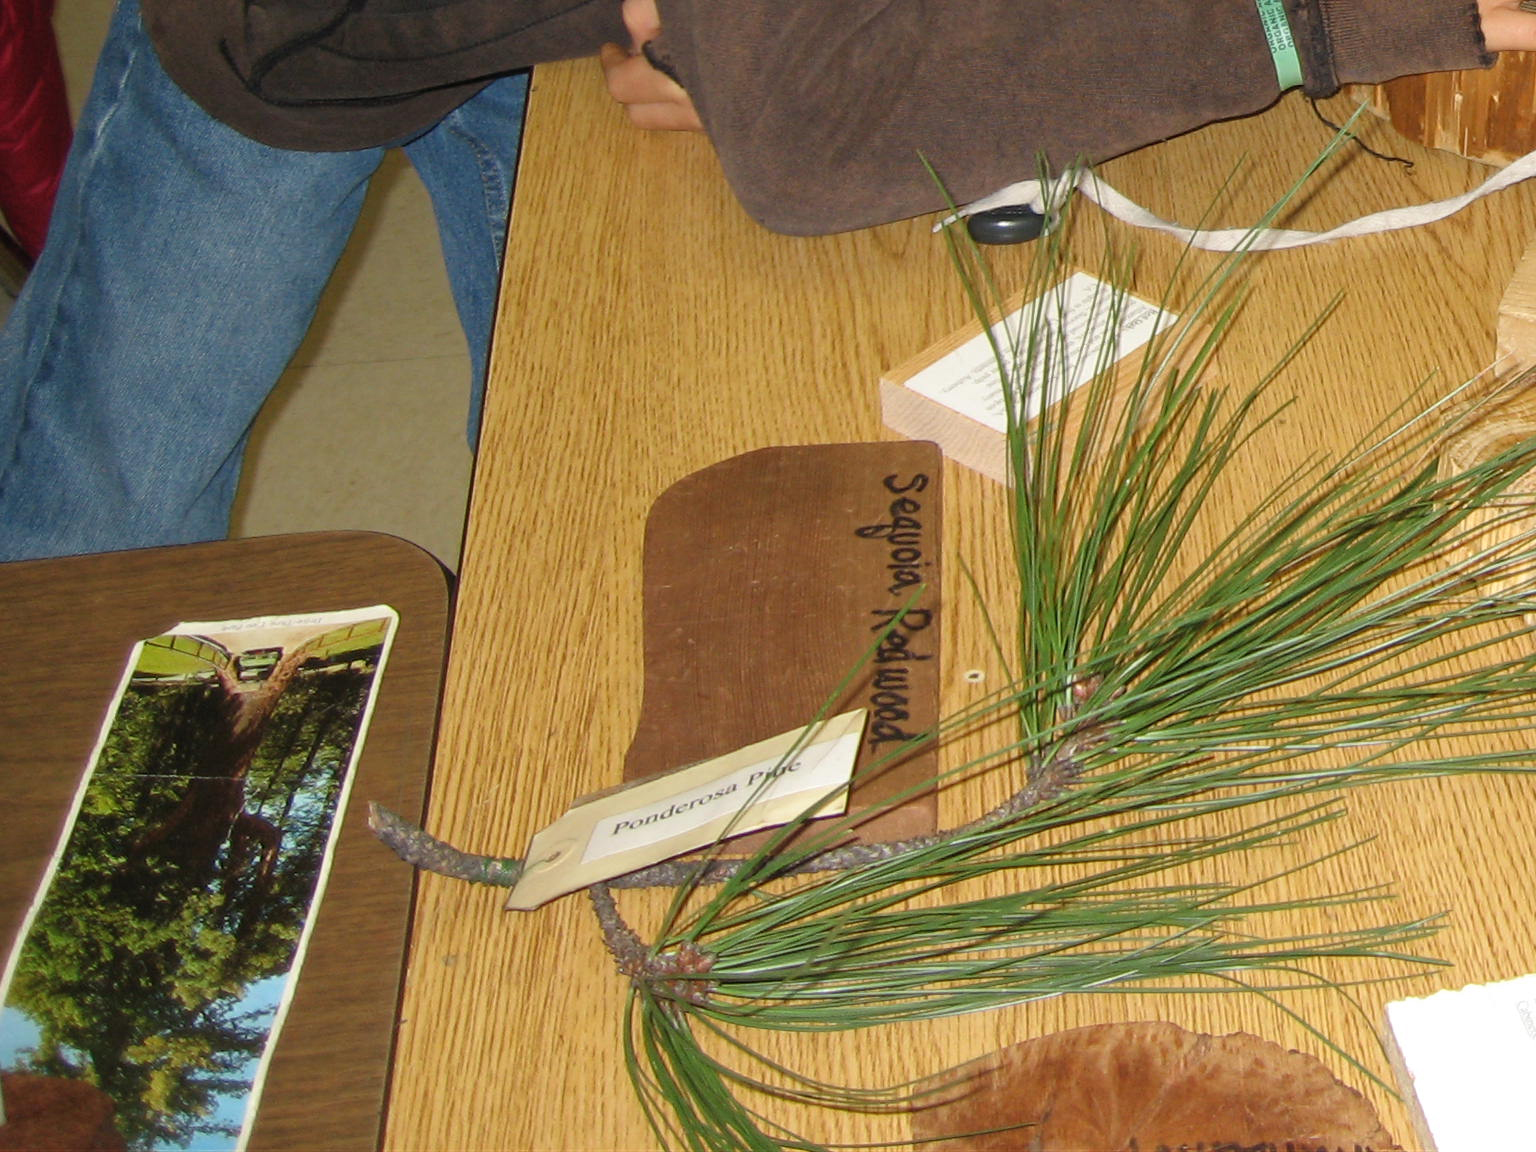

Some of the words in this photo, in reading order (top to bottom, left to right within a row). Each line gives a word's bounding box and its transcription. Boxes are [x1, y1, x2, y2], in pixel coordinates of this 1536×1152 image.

[1265, 6, 1287, 52] ORGANIC
[855, 473, 932, 597] Sequoia
[868, 608, 934, 754] Redwood
[613, 783, 738, 835] Ponderosa
